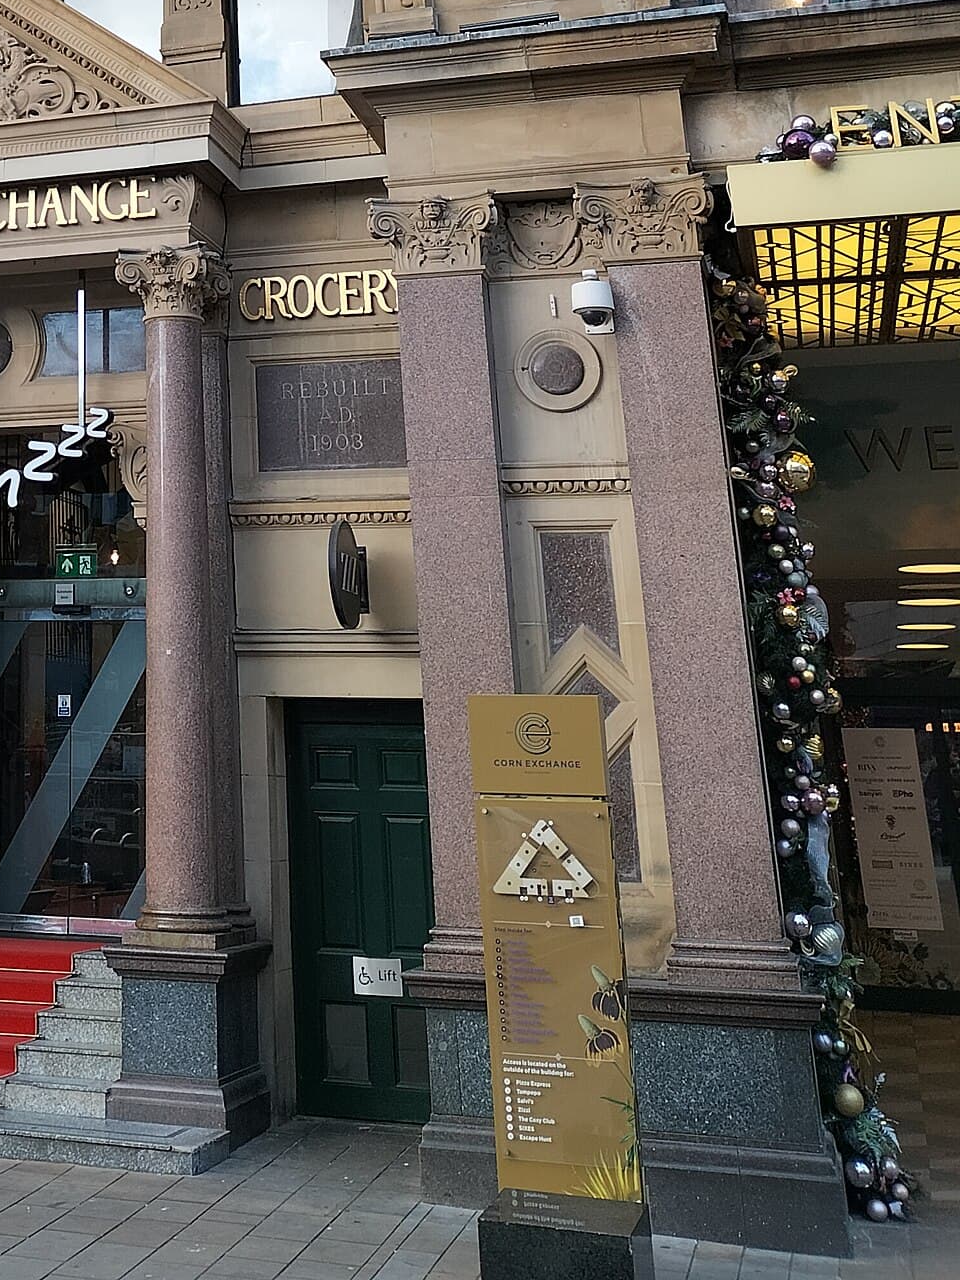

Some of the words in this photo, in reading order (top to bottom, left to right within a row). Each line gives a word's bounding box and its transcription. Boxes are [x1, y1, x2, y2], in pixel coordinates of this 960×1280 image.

[830, 95, 960, 151] EN
[281, 378, 391, 400] REBUILT
[310, 432, 364, 452] 1903
[493, 759, 522, 767] CORN
[525, 760, 581, 769] EXCHANGE
[378, 969, 398, 982] Lift
